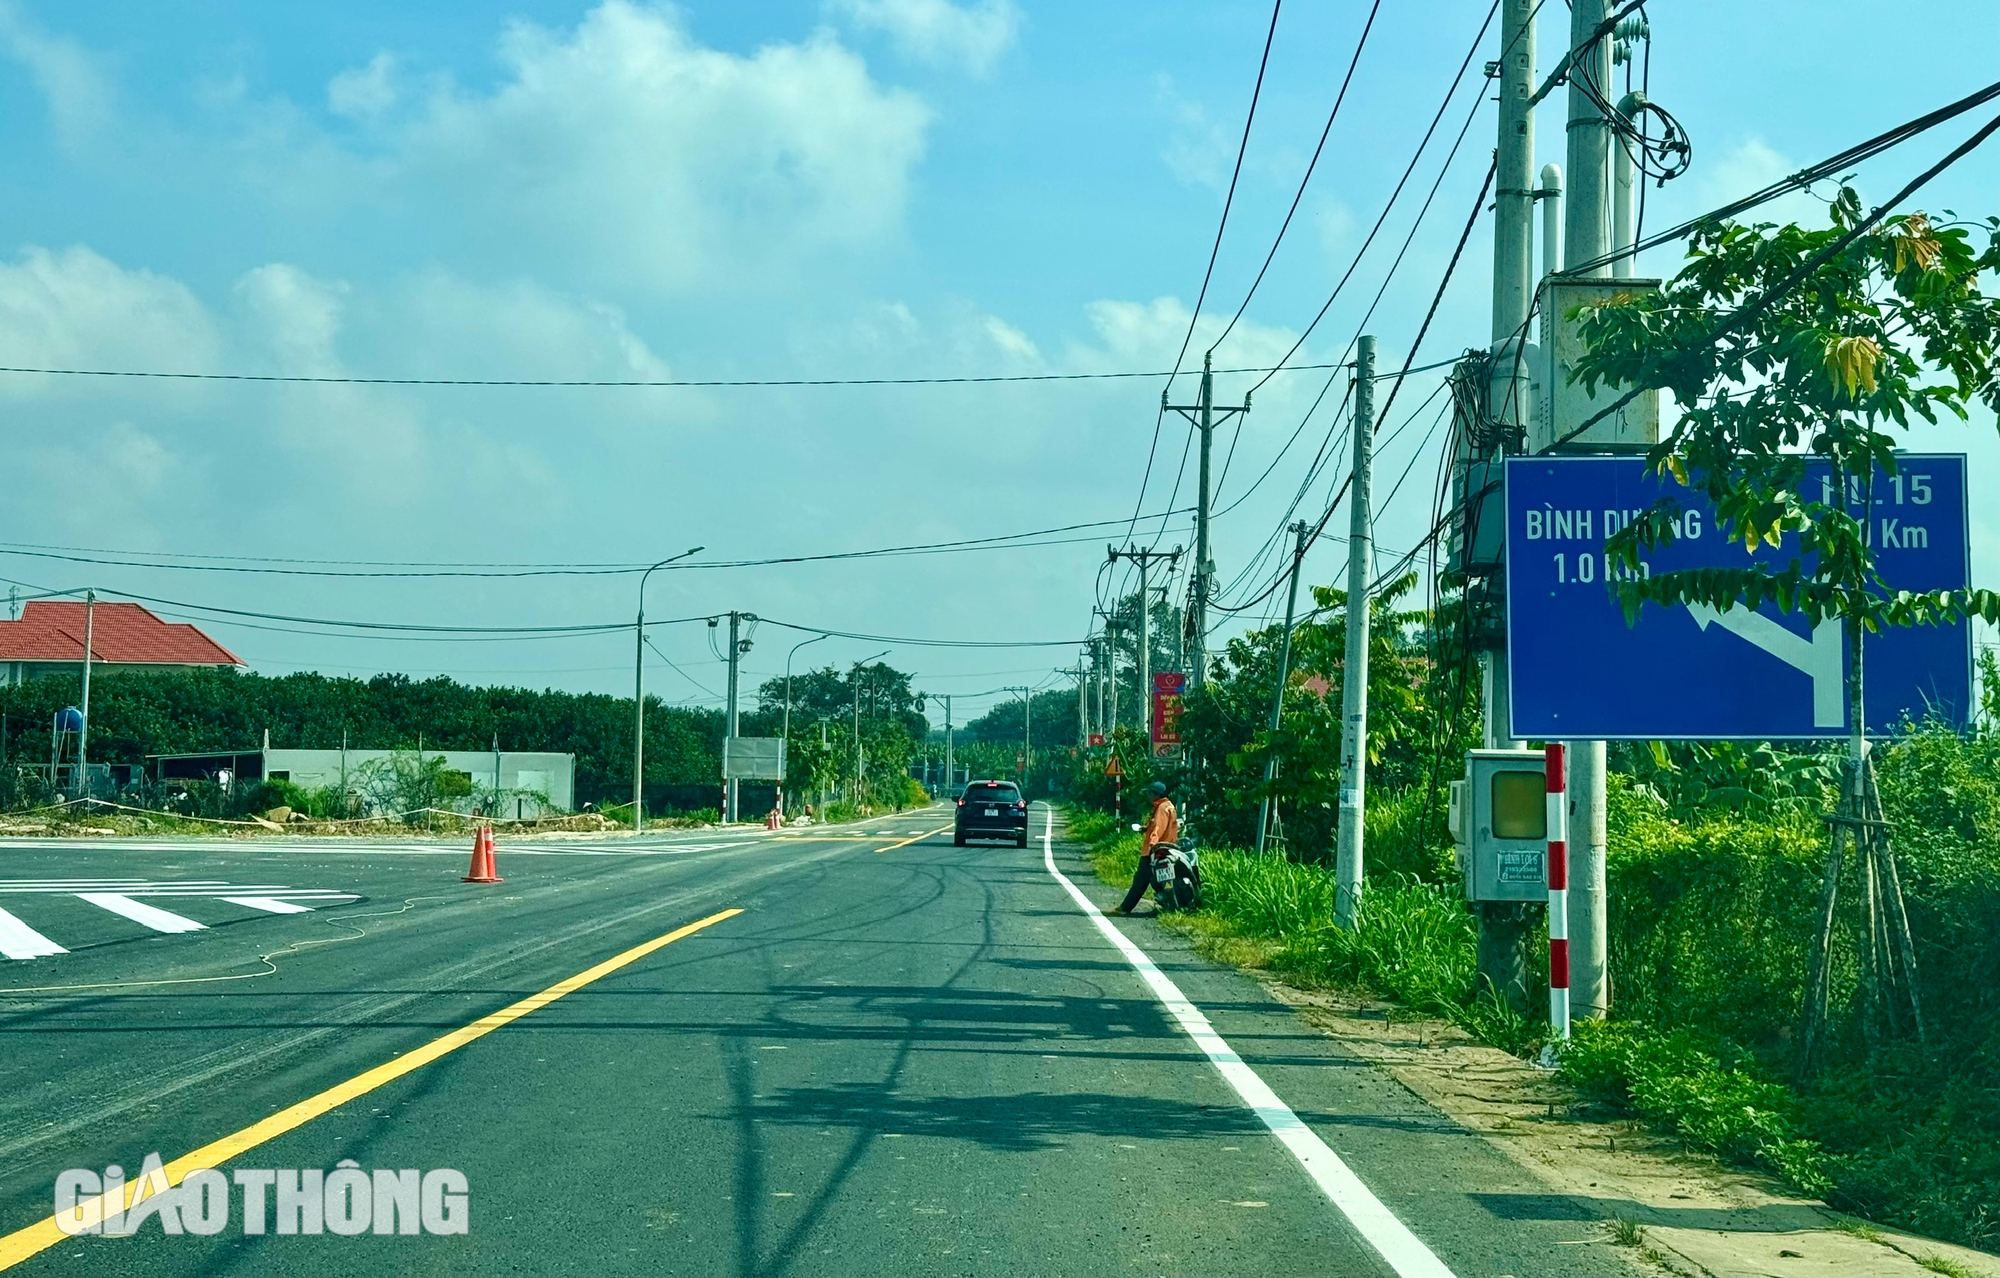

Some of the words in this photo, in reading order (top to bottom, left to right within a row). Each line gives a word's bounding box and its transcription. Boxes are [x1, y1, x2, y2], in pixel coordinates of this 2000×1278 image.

[1526, 502, 1593, 540] BÌNH
[1881, 518, 1928, 549] Km
[1553, 553, 1594, 583] 1.0
